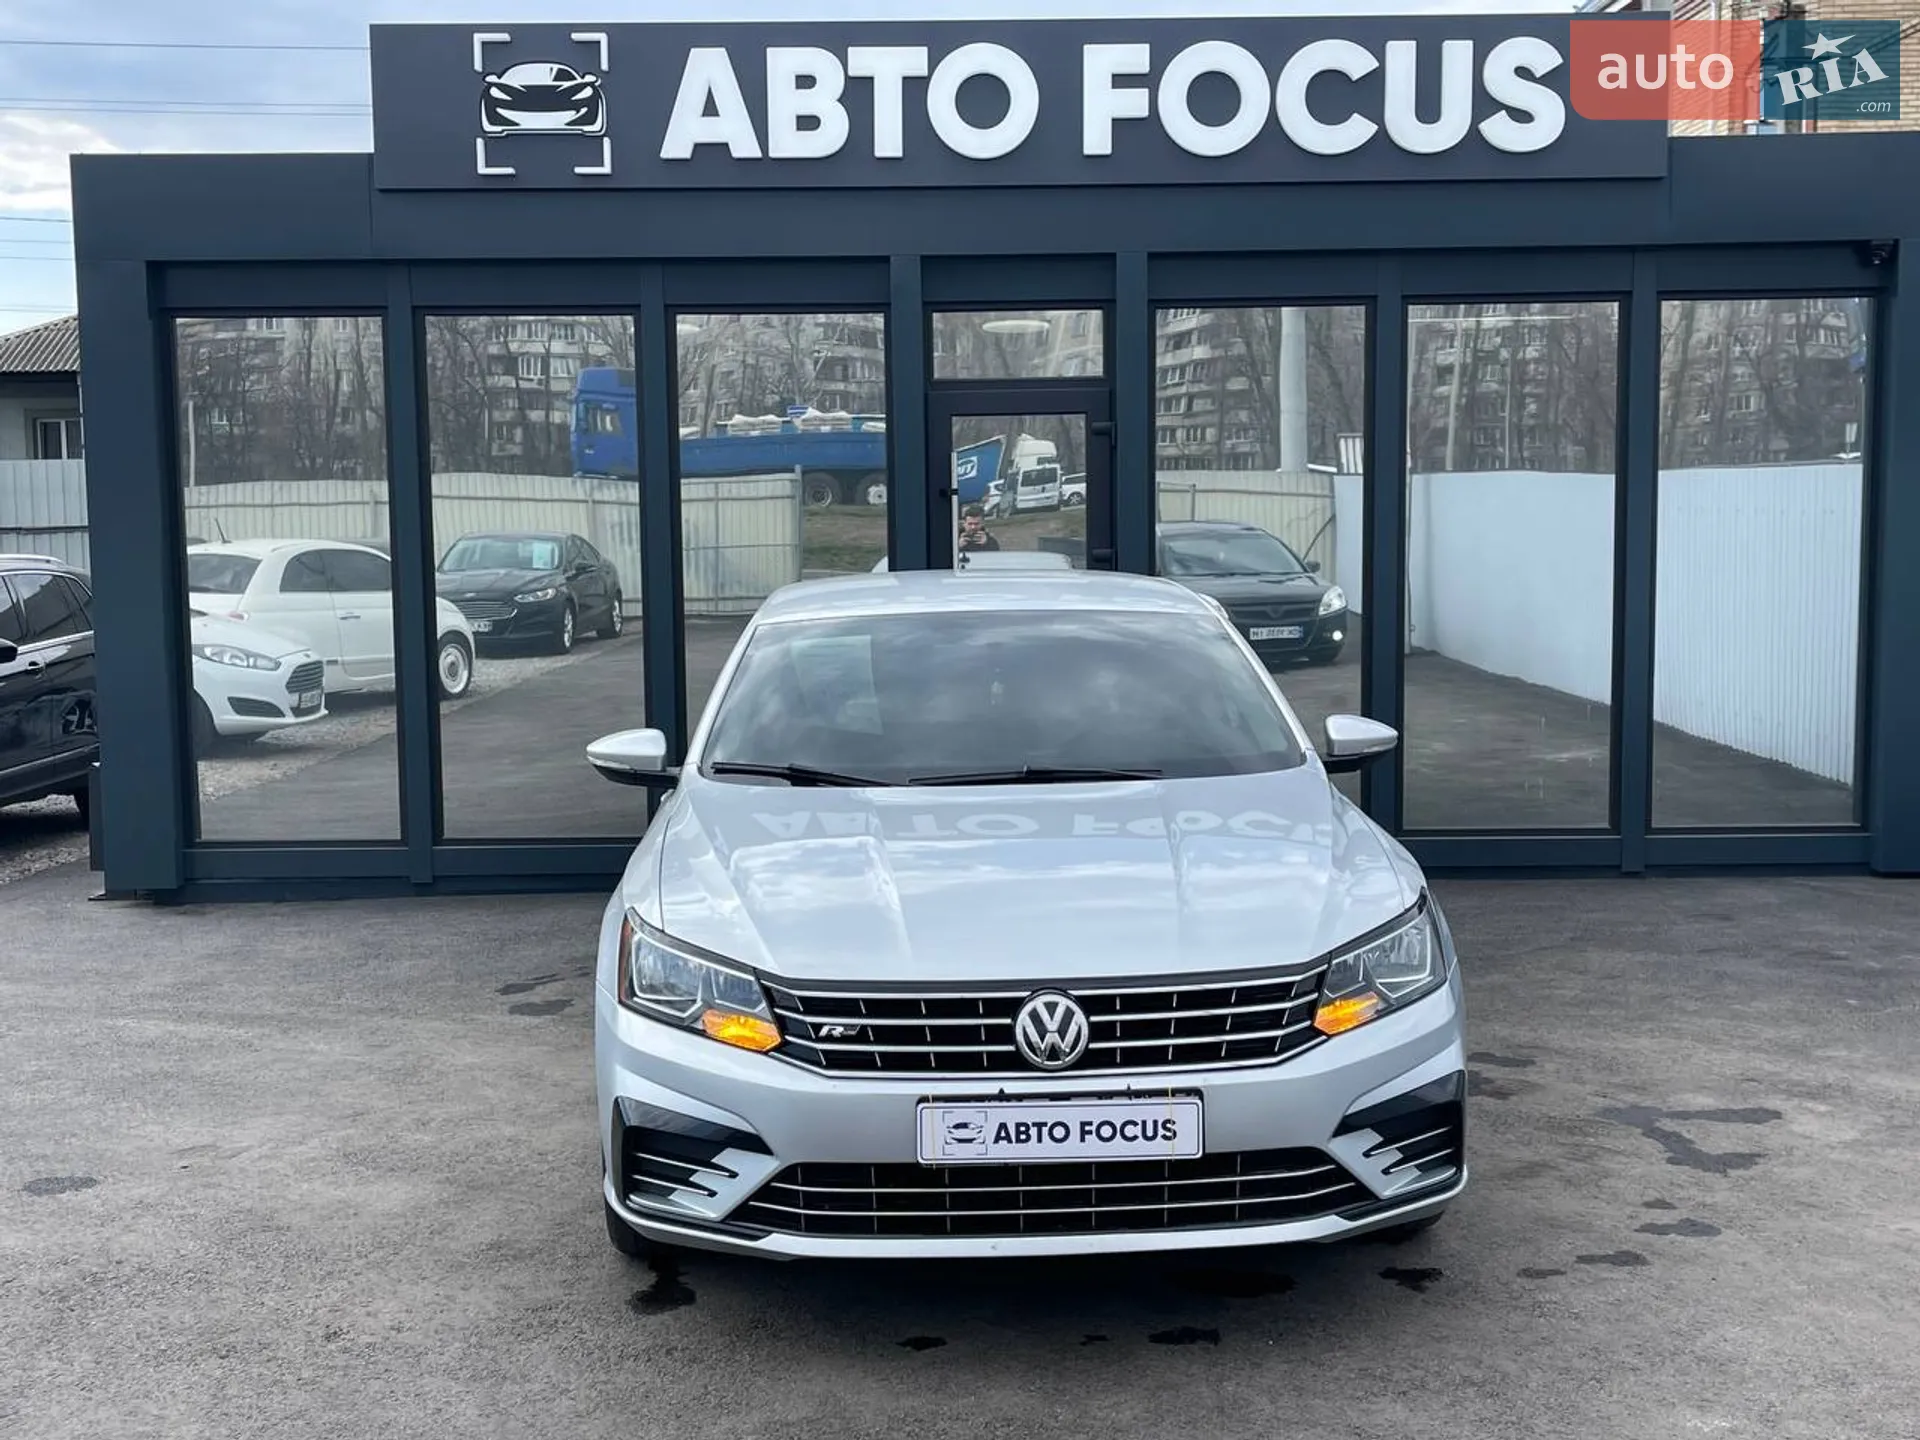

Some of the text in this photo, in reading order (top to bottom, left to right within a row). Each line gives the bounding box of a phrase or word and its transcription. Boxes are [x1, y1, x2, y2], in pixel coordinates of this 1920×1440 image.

[660, 36, 1567, 160] АВТО FOCUS
[993, 1118, 1178, 1145] АВТО FOCUS
